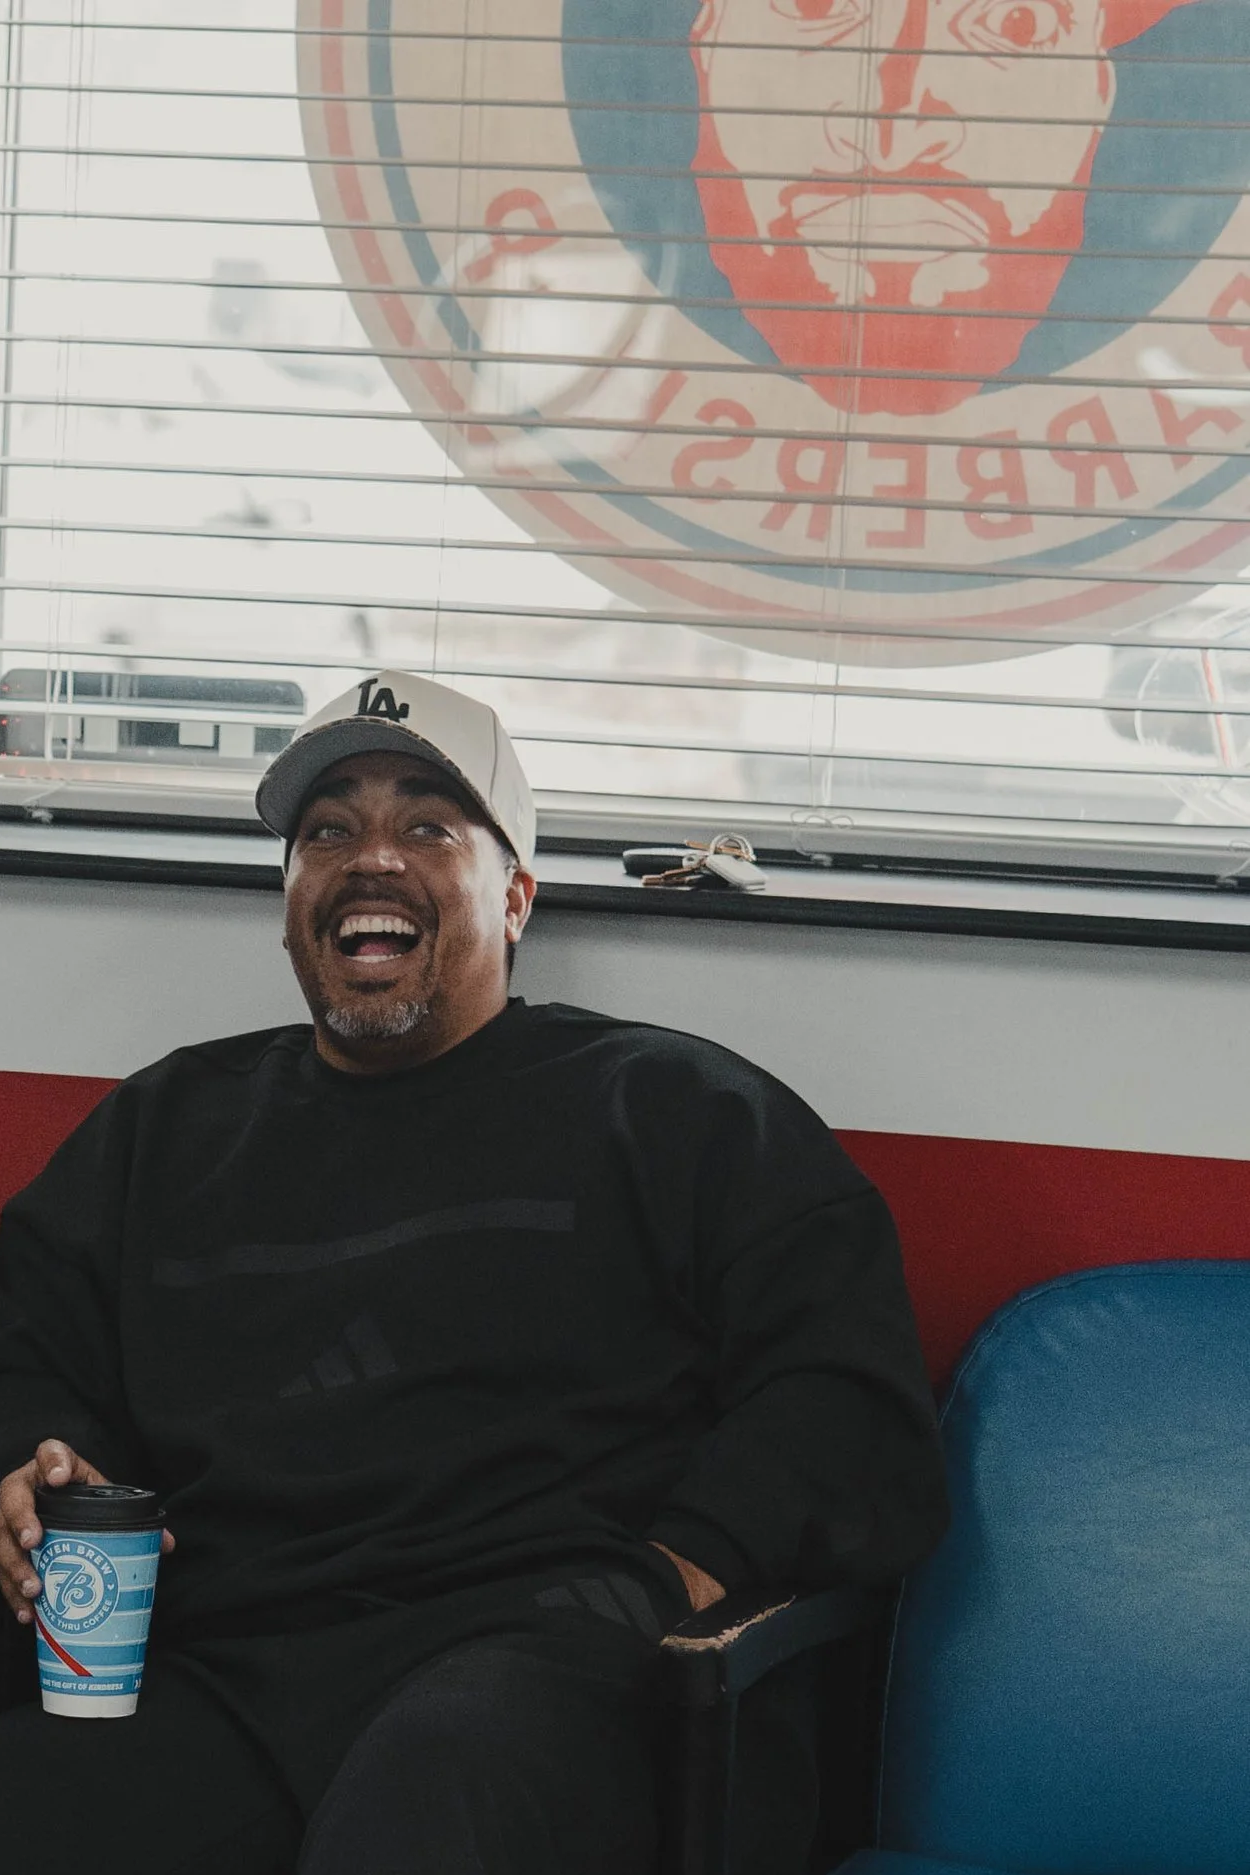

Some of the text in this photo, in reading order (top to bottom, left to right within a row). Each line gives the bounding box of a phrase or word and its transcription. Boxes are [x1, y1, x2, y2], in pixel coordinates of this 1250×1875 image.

[351, 678, 410, 723] LA
[39, 1543, 113, 1575] SEVEN BREW
[48, 1561, 97, 1616] 7B
[40, 1595, 112, 1631] DRIVE THRU COFFEE
[62, 1682, 77, 1690] GIFT
[77, 1683, 88, 1691] OF
